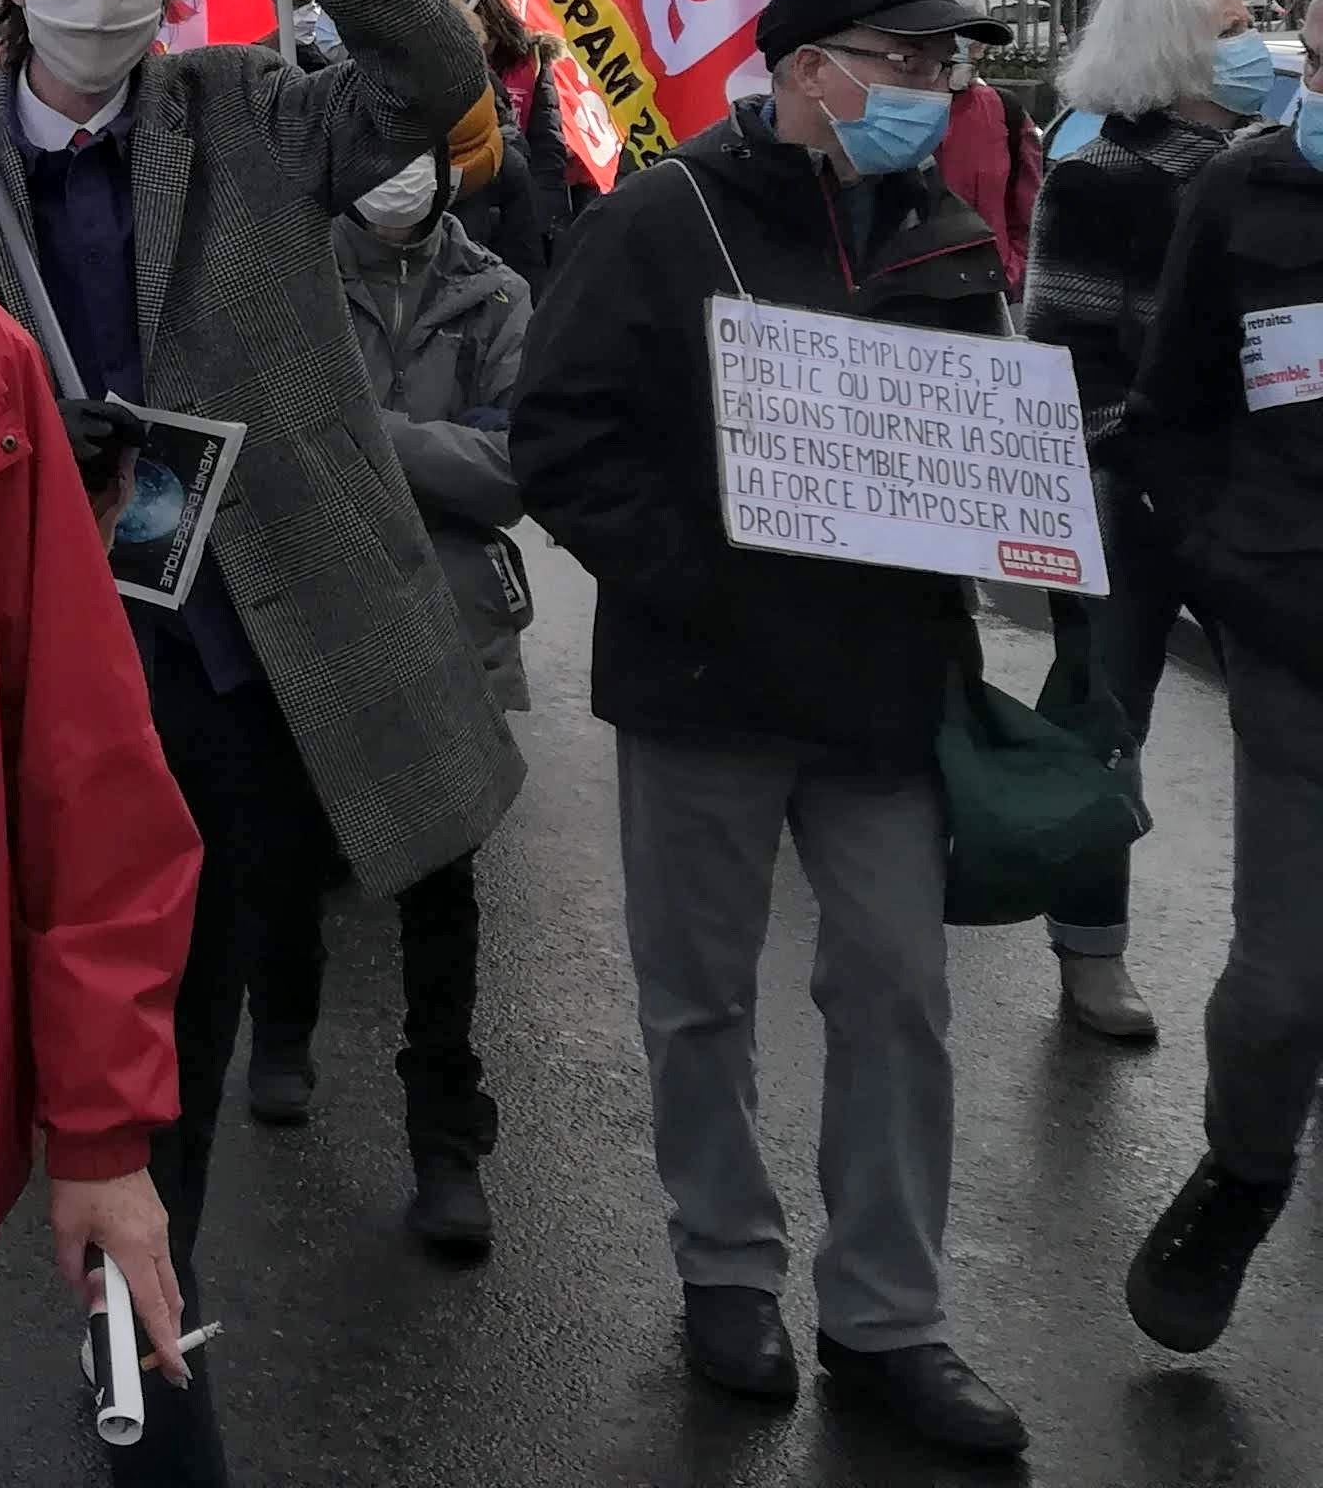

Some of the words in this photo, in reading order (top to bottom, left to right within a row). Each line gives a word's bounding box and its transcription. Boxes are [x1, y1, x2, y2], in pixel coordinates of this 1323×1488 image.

[722, 352, 822, 394] PUBLIC
[837, 370, 869, 399] OU
[879, 377, 911, 408] DU
[1015, 397, 1080, 431] NOUS
[991, 357, 1022, 387] DU
[722, 388, 835, 432] FAISONS
[839, 405, 951, 451] TOURNER
[961, 427, 986, 453] LA
[189, 439, 218, 491] AVENIR
[918, 455, 982, 490] NOUS
[987, 466, 1071, 504] AVONS
[737, 464, 764, 497] LA
[772, 471, 857, 510] FORCE
[867, 481, 1010, 532] D'IMPOSER
[1019, 507, 1074, 540] NOS
